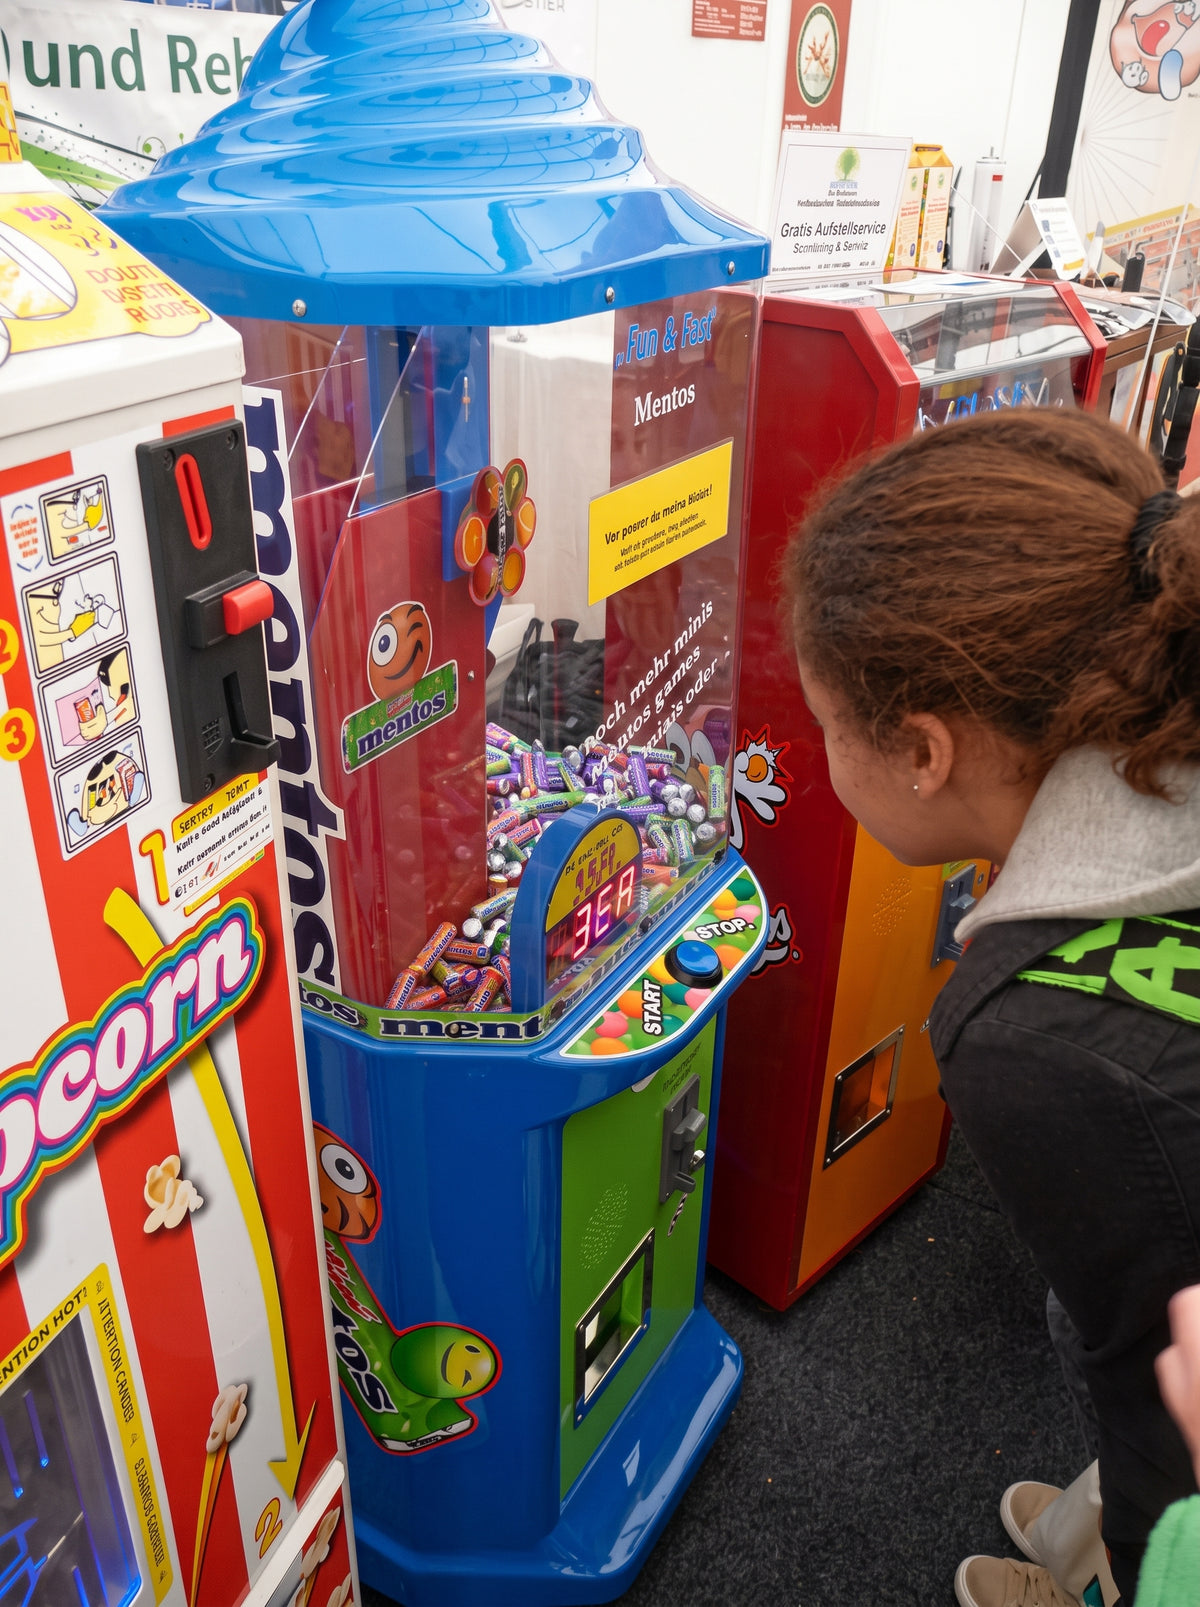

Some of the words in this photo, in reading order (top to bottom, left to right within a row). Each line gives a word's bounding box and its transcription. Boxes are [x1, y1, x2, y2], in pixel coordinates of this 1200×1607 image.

[22, 28, 146, 91] und
[781, 222, 813, 238] Gratis
[814, 221, 887, 237] Aufstellservice
[835, 241, 842, 252] &
[663, 314, 679, 353] &
[633, 382, 696, 427] Mentos
[629, 648, 672, 706] mehr
[674, 600, 714, 656] minis
[654, 645, 701, 715] games
[4, 716, 28, 755] 3
[357, 690, 448, 760] mentos
[642, 978, 663, 1036] START
[255, 1497, 284, 1560] 2
